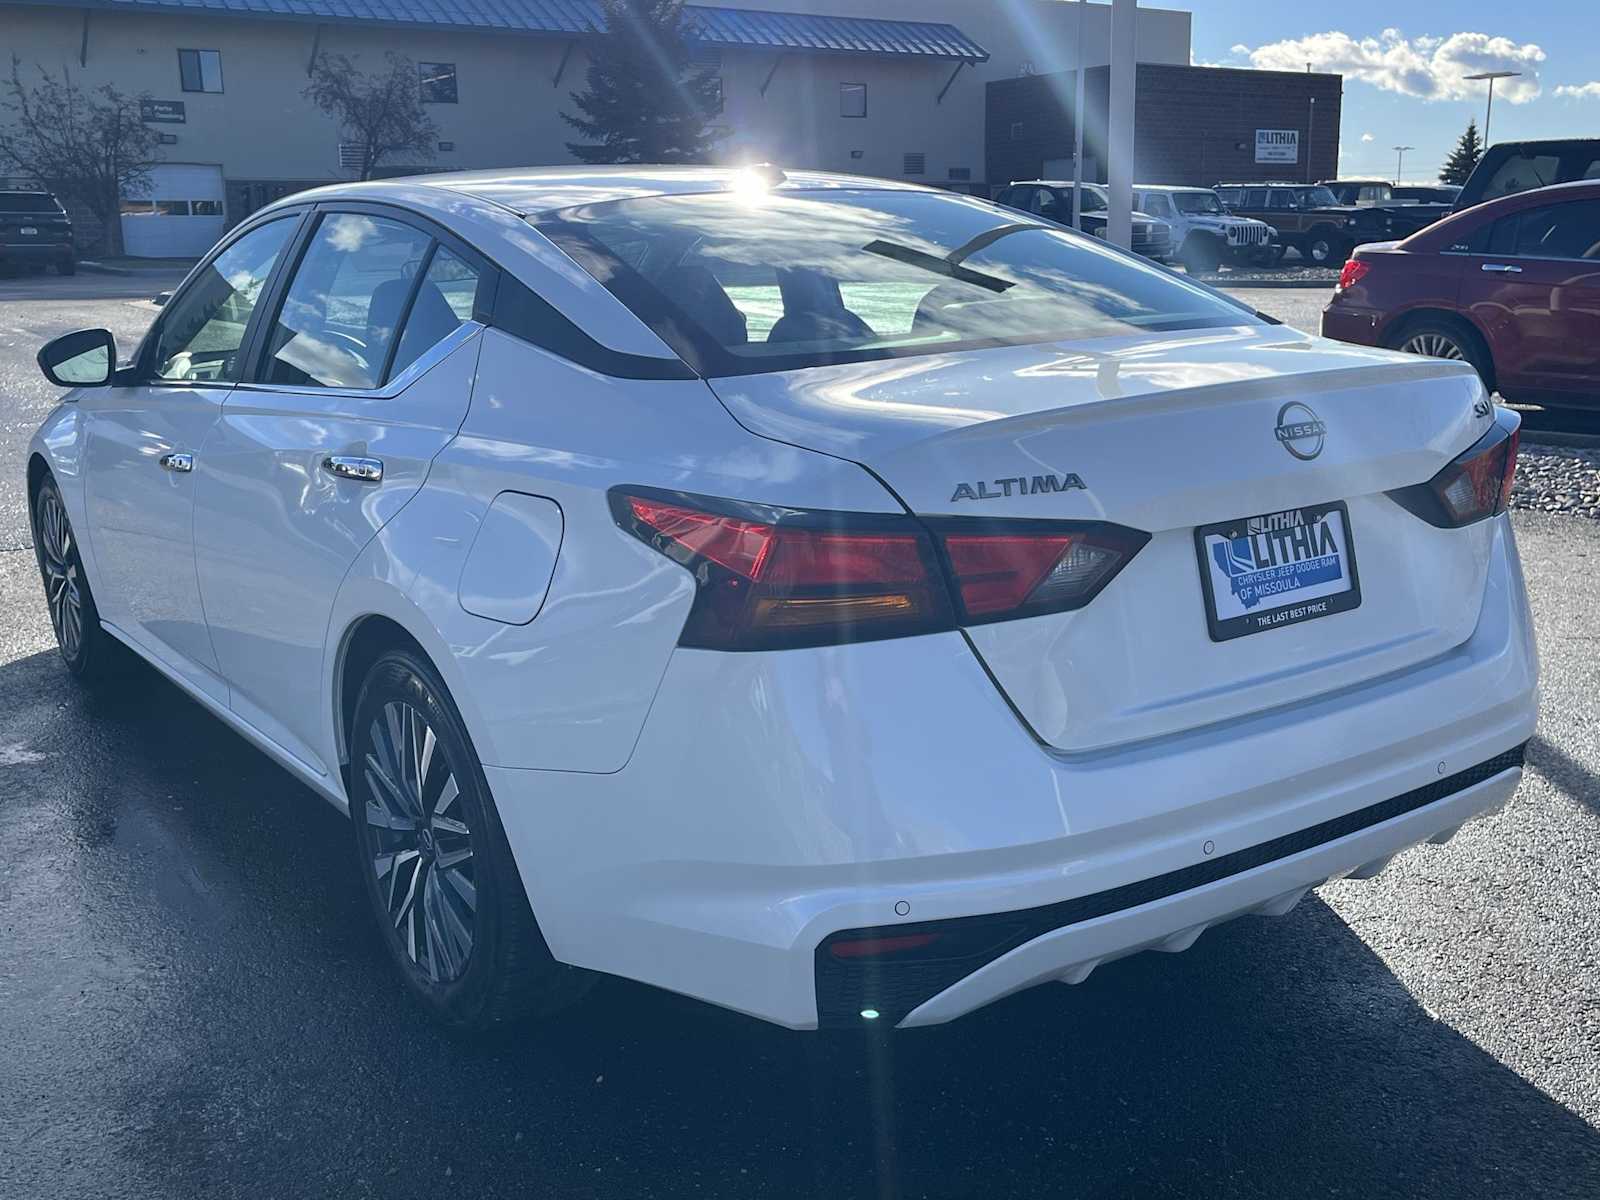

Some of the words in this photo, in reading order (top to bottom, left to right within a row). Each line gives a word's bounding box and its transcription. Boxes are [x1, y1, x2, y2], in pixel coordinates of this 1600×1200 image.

[1266, 131, 1297, 144] LITHIA
[1278, 423, 1326, 438] NISSAN
[950, 473, 1088, 502] ALTIMA
[1261, 510, 1304, 533] LITHIA
[1251, 522, 1338, 570] LITHIA
[1238, 570, 1276, 586] CHRYSLER
[1277, 566, 1295, 578] JEEP
[1295, 561, 1321, 573] DODGE
[1321, 557, 1336, 568] RAM
[1240, 587, 1253, 600] OF
[1255, 577, 1301, 597] MISSOULA
[1257, 616, 1272, 627] THE
[1272, 611, 1289, 624] LAST
[1290, 606, 1306, 619] BEST
[1307, 602, 1327, 615] PRICE
